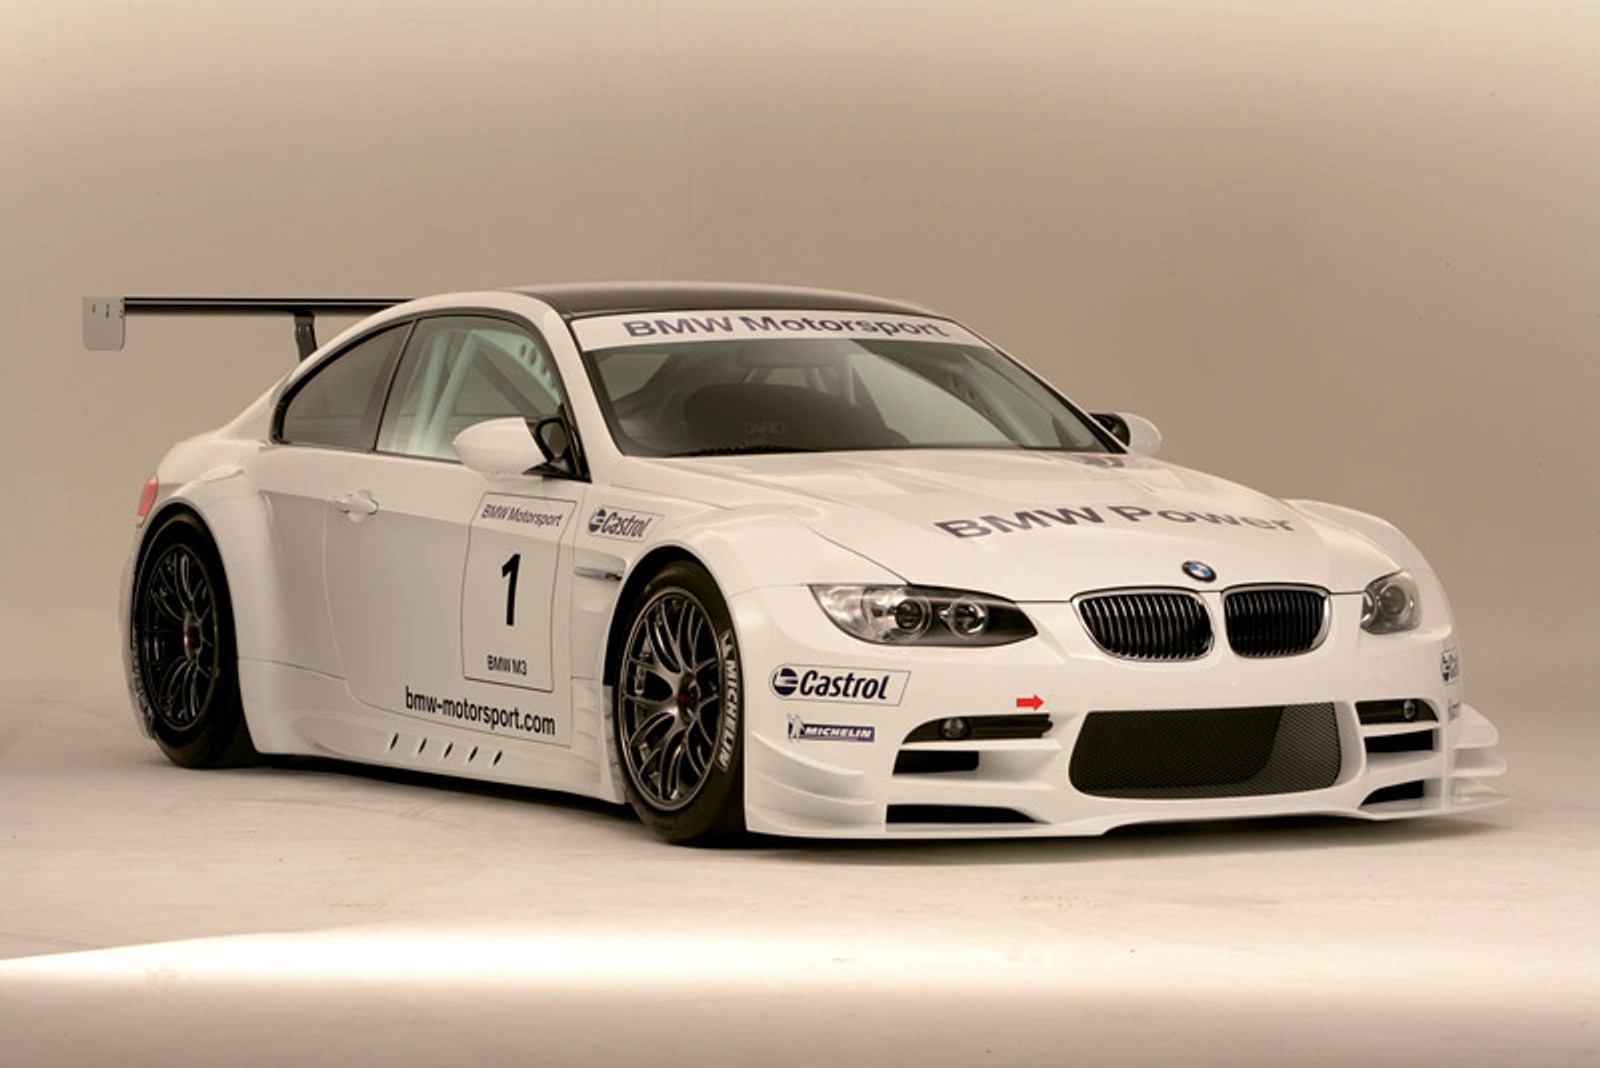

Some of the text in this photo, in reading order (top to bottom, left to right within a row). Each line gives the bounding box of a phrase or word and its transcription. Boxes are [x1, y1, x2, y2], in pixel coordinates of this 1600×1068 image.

[623, 316, 949, 338] BMW Motorsport
[482, 504, 563, 528] BMW Motorsport
[601, 511, 653, 538] Castrol
[934, 505, 1294, 539] BMW Power
[501, 553, 521, 627] 1
[487, 655, 528, 676] BMW M3
[799, 669, 889, 700] Castrol
[406, 685, 556, 735] bmw-motorsport.com
[719, 660, 739, 770] MICHELIN
[804, 726, 871, 738] MICHELIN
